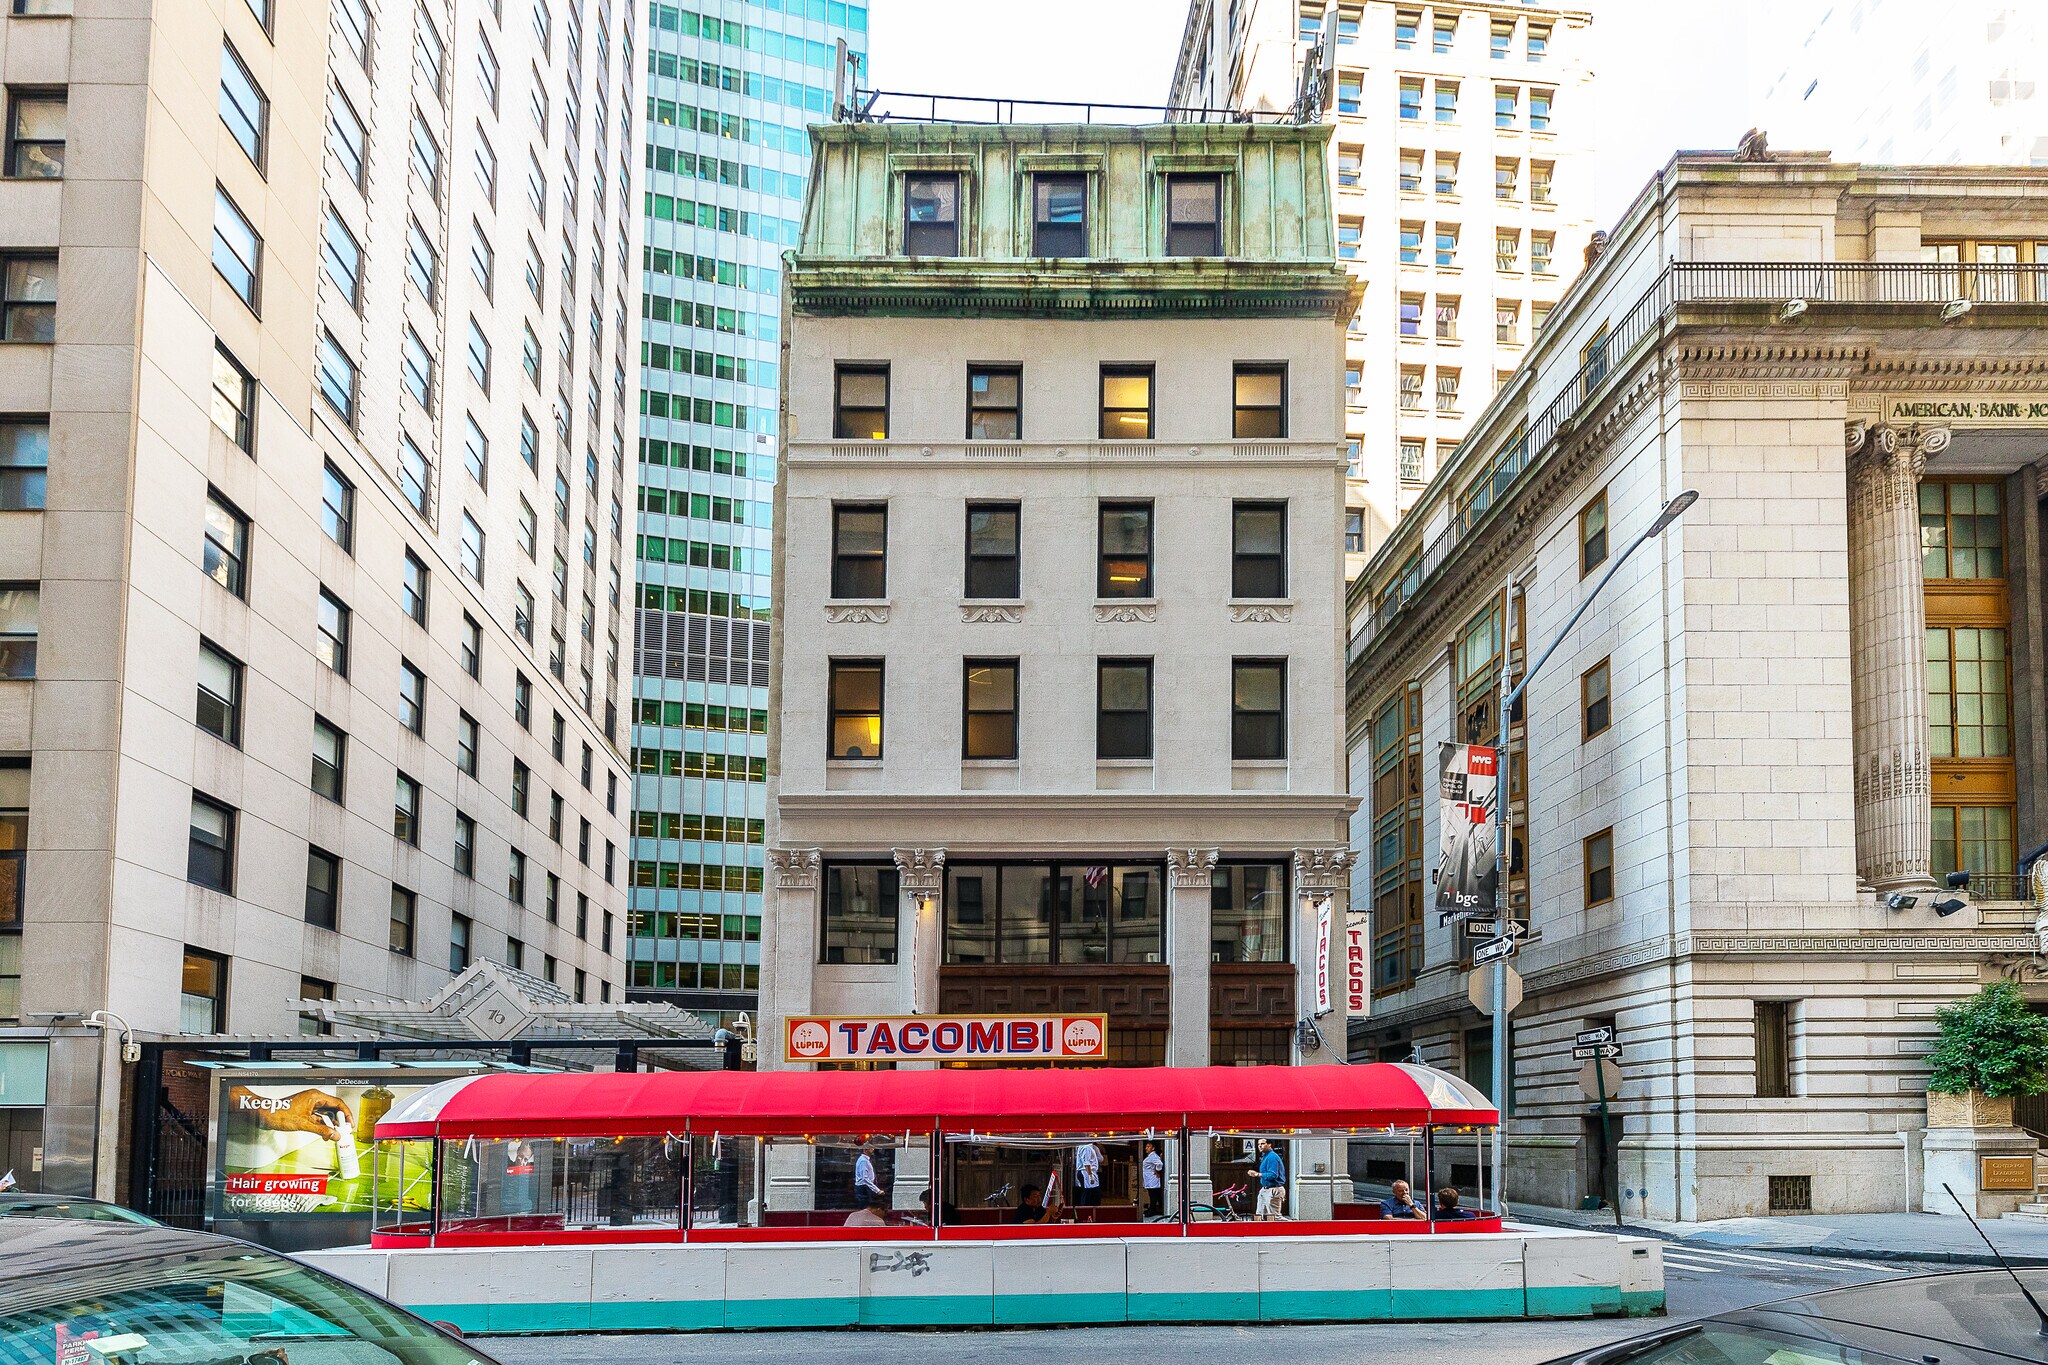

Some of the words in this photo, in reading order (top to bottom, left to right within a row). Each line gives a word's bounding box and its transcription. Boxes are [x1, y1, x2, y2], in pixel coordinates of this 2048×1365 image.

[1979, 402, 2021, 417] BANK
[1471, 755, 1492, 765] NYC
[1455, 890, 1479, 907] bgc
[1474, 923, 1493, 933] ONE
[1477, 947, 1490, 959] ONE
[1494, 939, 1509, 953] WAY
[1318, 920, 1328, 1005] TACOS
[1348, 930, 1363, 1011] TACOS
[488, 1009, 506, 1025] 76
[838, 1021, 1054, 1055] TACOMBI
[1595, 1031, 1606, 1039] WAY
[795, 1040, 825, 1050] LUPITA
[1067, 1038, 1097, 1048] LUPITA
[1600, 1047, 1614, 1055] WAY
[239, 1095, 291, 1114] Keeps
[1245, 1140, 1253, 1149] A
[232, 1177, 261, 1189] Hair
[264, 1178, 320, 1192] growing
[231, 1196, 251, 1207] for
